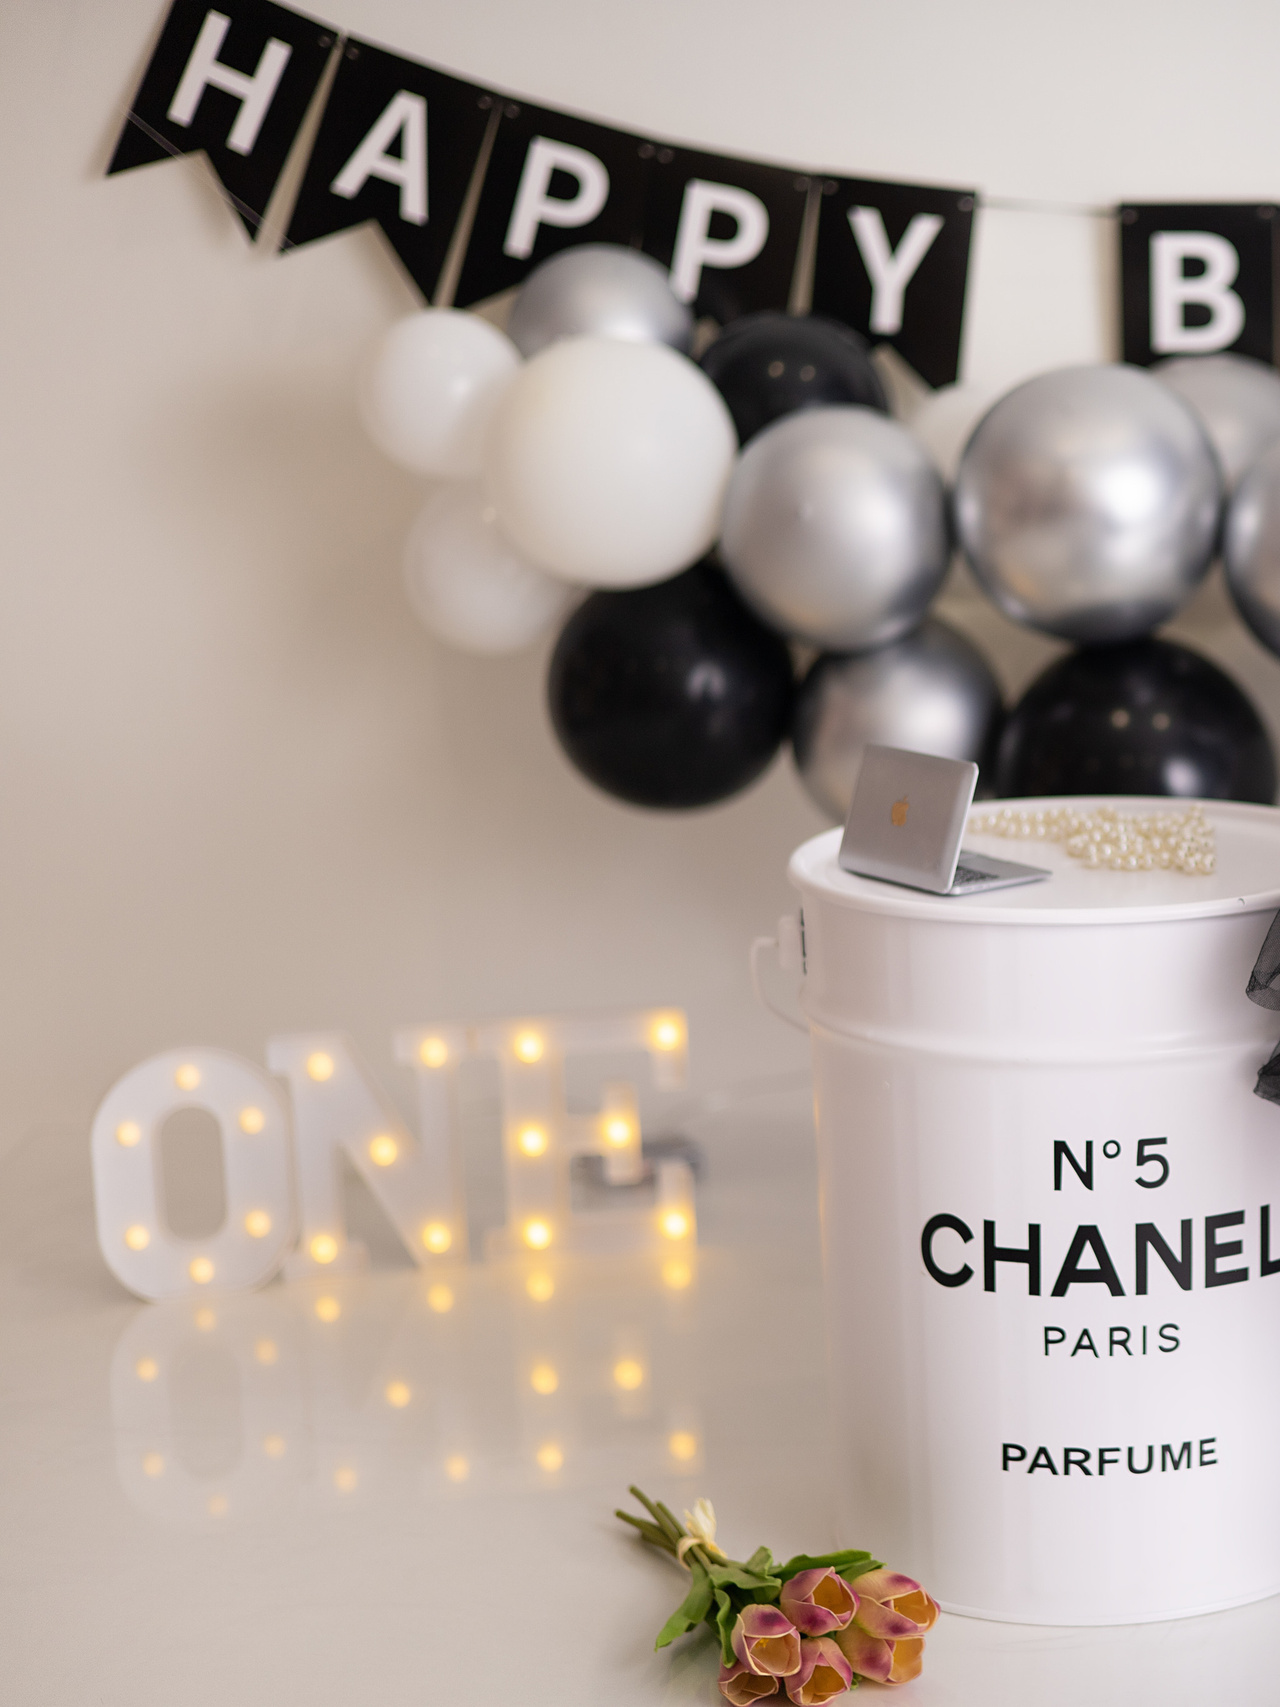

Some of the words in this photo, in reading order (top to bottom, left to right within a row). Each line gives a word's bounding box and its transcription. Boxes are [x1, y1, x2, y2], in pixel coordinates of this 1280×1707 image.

[166, 10, 945, 336] HAPPY
[90, 1006, 698, 1303] ONE
[1043, 1323, 1181, 1359] PARIS
[1001, 1436, 1218, 1477] PARFUME
